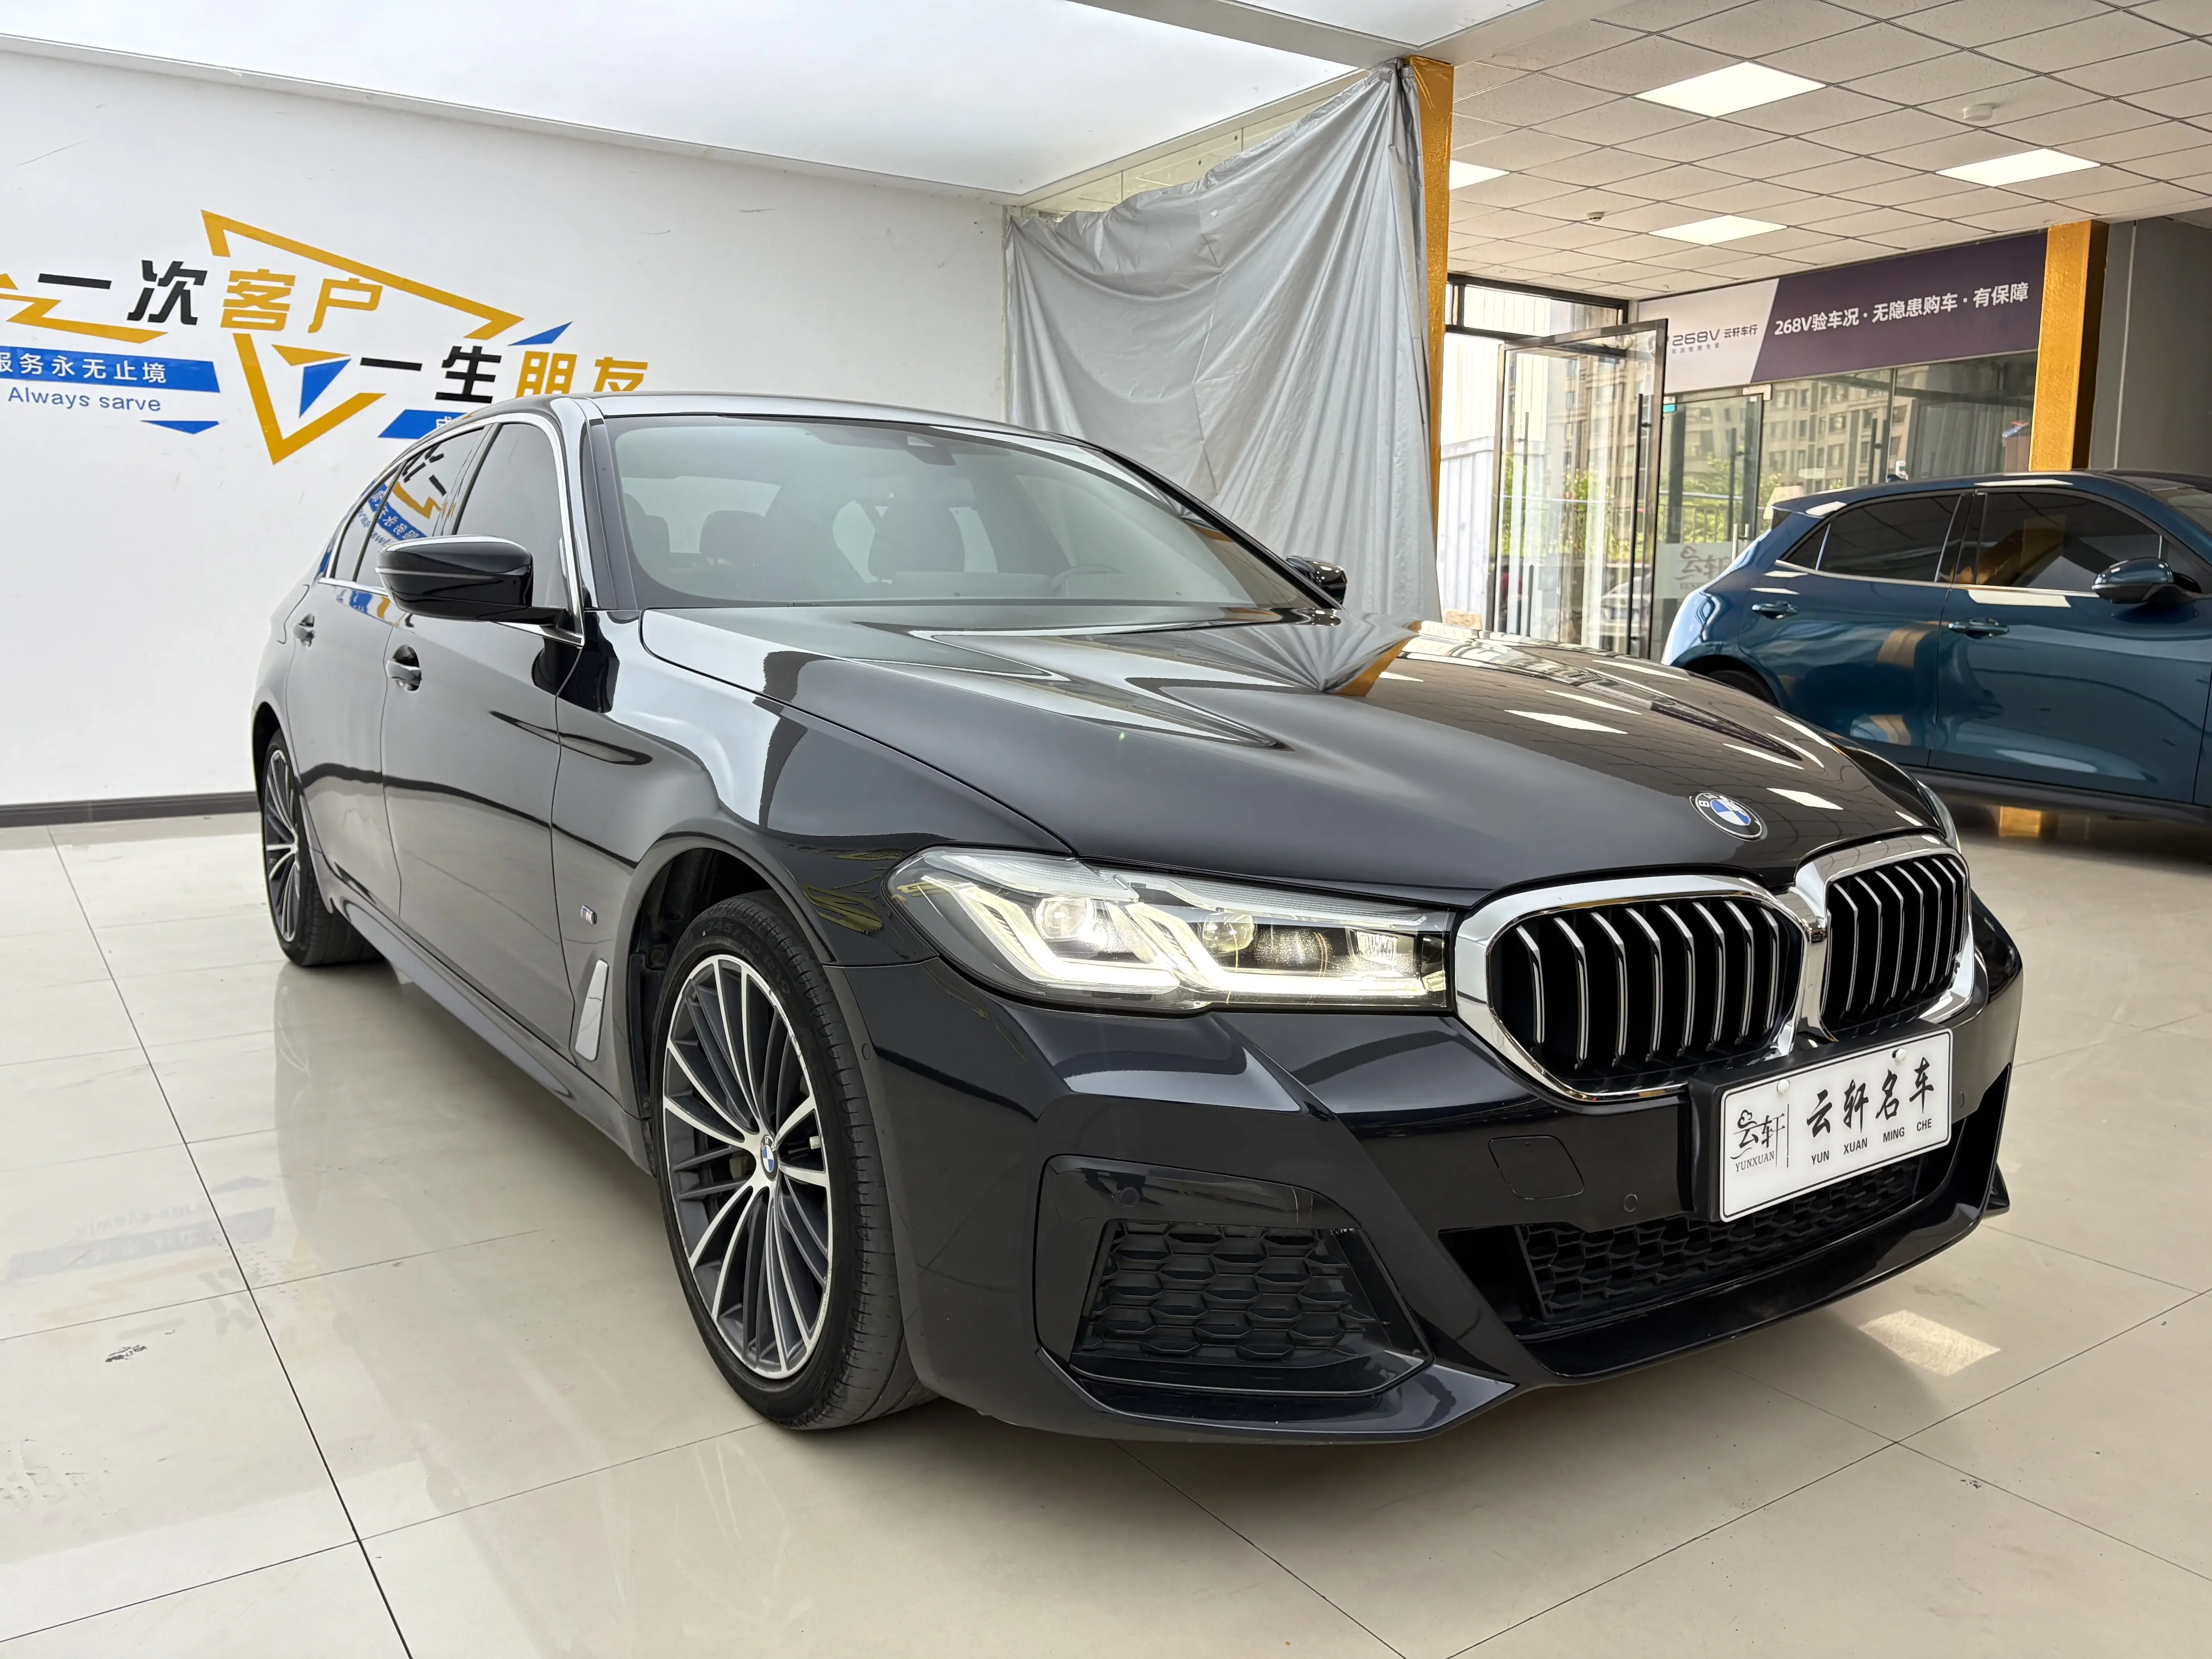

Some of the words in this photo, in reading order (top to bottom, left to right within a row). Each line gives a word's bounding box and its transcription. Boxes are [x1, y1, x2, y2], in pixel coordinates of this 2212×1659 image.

[38, 260, 383, 334] 一次客户
[1672, 329, 1720, 346] 268V
[8, 387, 90, 409] Always
[99, 396, 161, 411] sarve
[1806, 1057, 1935, 1138] 云轩名车
[1811, 1150, 1830, 1165] YUN
[1843, 1137, 1868, 1155] XUAN
[1882, 1127, 1905, 1143] MING
[1916, 1118, 1932, 1132] CHE
[1735, 1151, 1775, 1173] YUNXUAN
